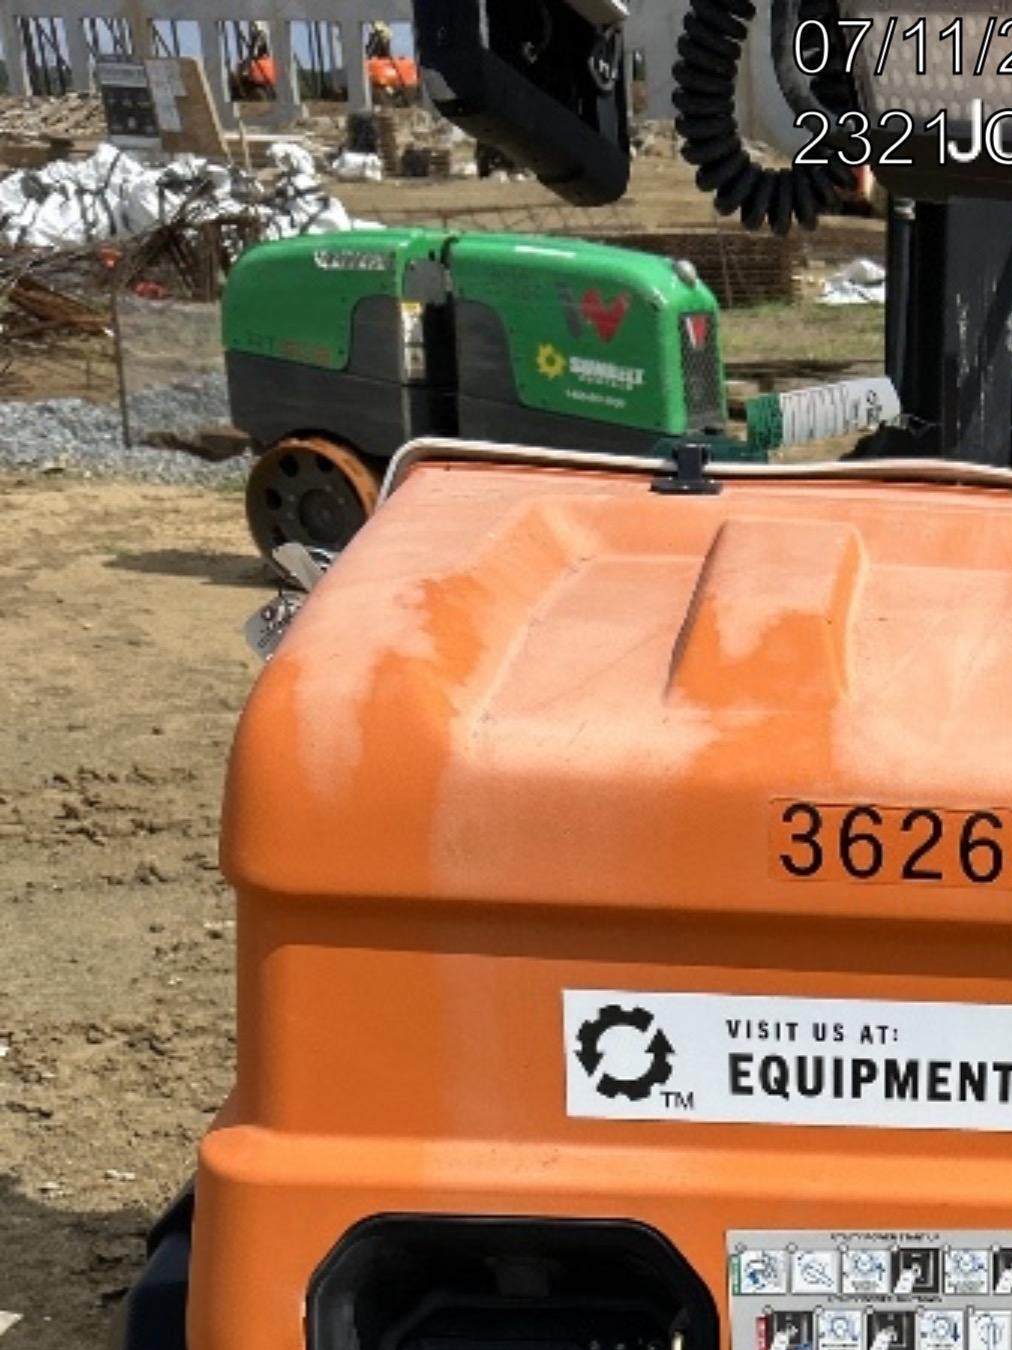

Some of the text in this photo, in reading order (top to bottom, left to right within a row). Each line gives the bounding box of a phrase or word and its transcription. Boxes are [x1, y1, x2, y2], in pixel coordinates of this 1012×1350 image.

[726, 1018, 898, 1045] VISIT US AT:
[659, 1090, 694, 1110] TM
